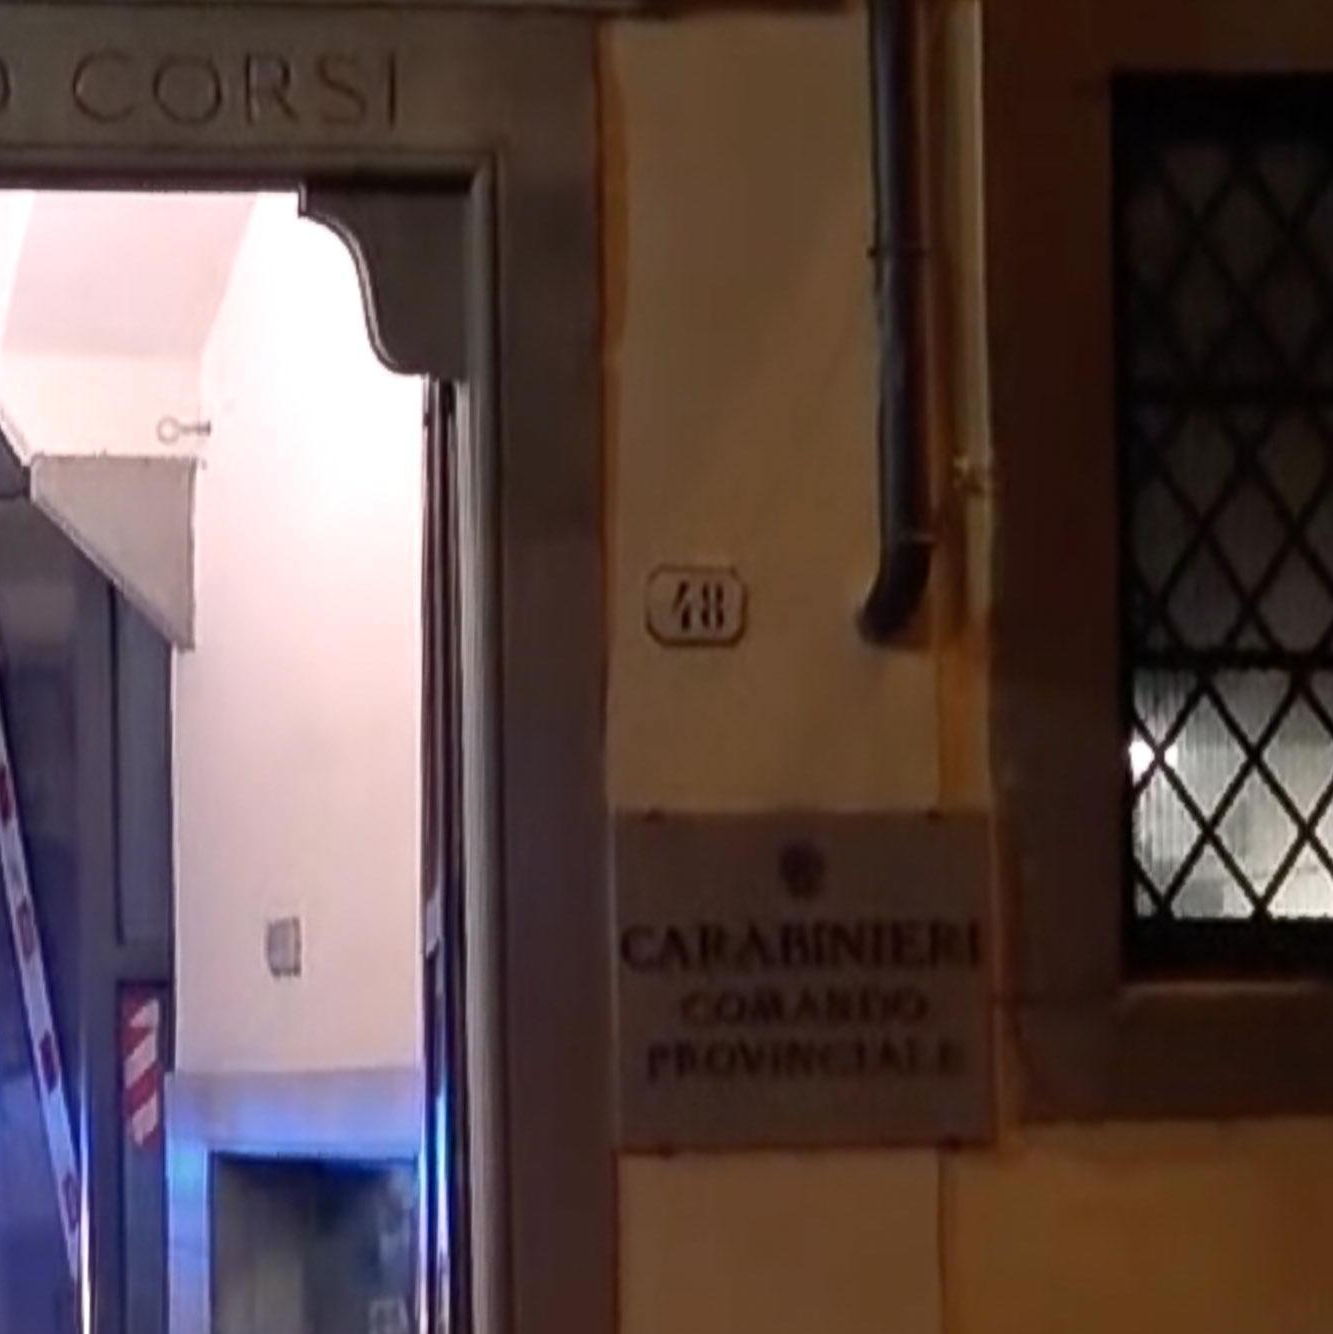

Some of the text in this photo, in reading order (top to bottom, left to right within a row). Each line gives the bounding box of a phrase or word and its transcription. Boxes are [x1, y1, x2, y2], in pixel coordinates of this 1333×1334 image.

[70, 49, 399, 127] CORSI
[669, 580, 727, 632] 48
[621, 920, 983, 971] CARABINIERI
[646, 1040, 963, 1080] PROVINCIALE
